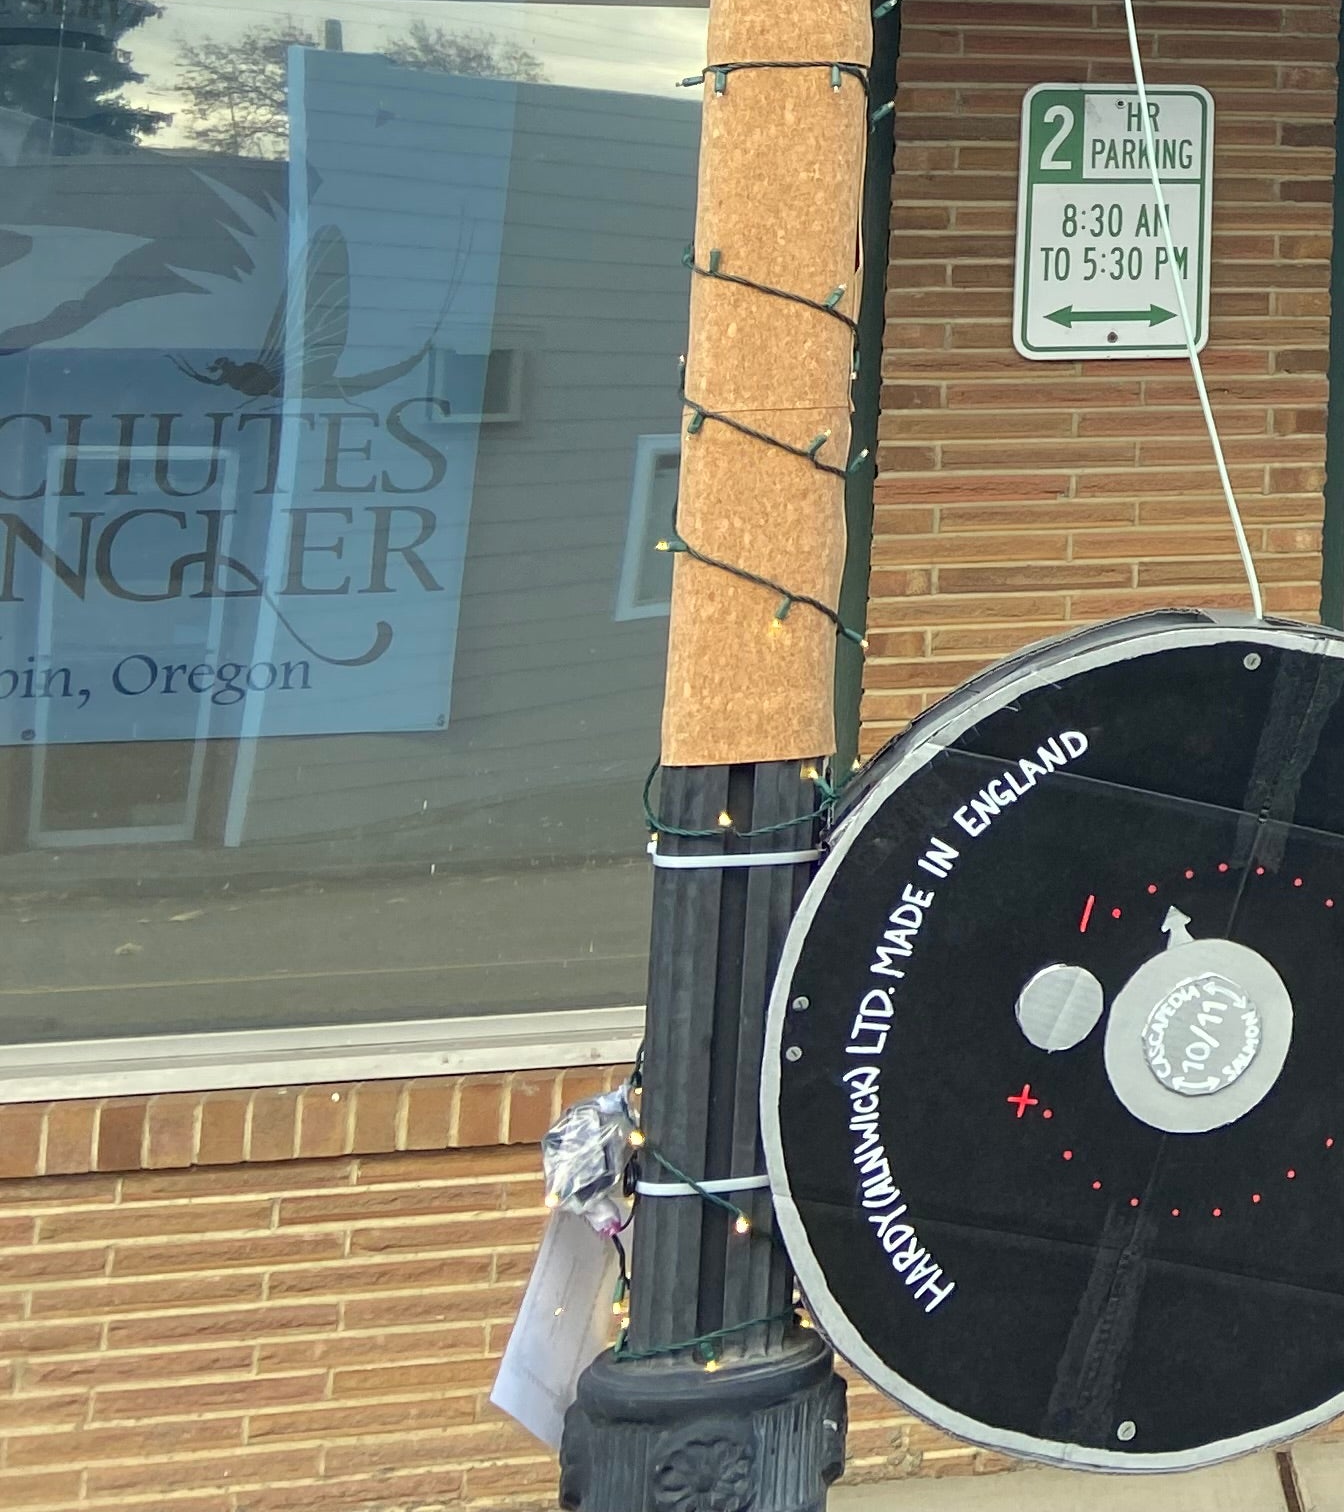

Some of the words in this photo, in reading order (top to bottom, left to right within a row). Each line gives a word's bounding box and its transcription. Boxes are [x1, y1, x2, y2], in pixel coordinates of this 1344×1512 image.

[1040, 104, 1075, 171] 2
[1127, 102, 1160, 132] HR
[1091, 138, 1193, 169] PARKING
[1062, 203, 1123, 238] 8:30
[1040, 246, 1071, 281] TO
[1083, 246, 1142, 281] 5:30
[1155, 246, 1188, 280] PM
[112, 653, 313, 706] Oregon
[953, 730, 1090, 838] ENGLAND
[917, 837, 960, 878] IN
[870, 883, 936, 979] MADE
[845, 986, 896, 1055] LTD.
[1181, 1000, 1229, 1074] 10/11
